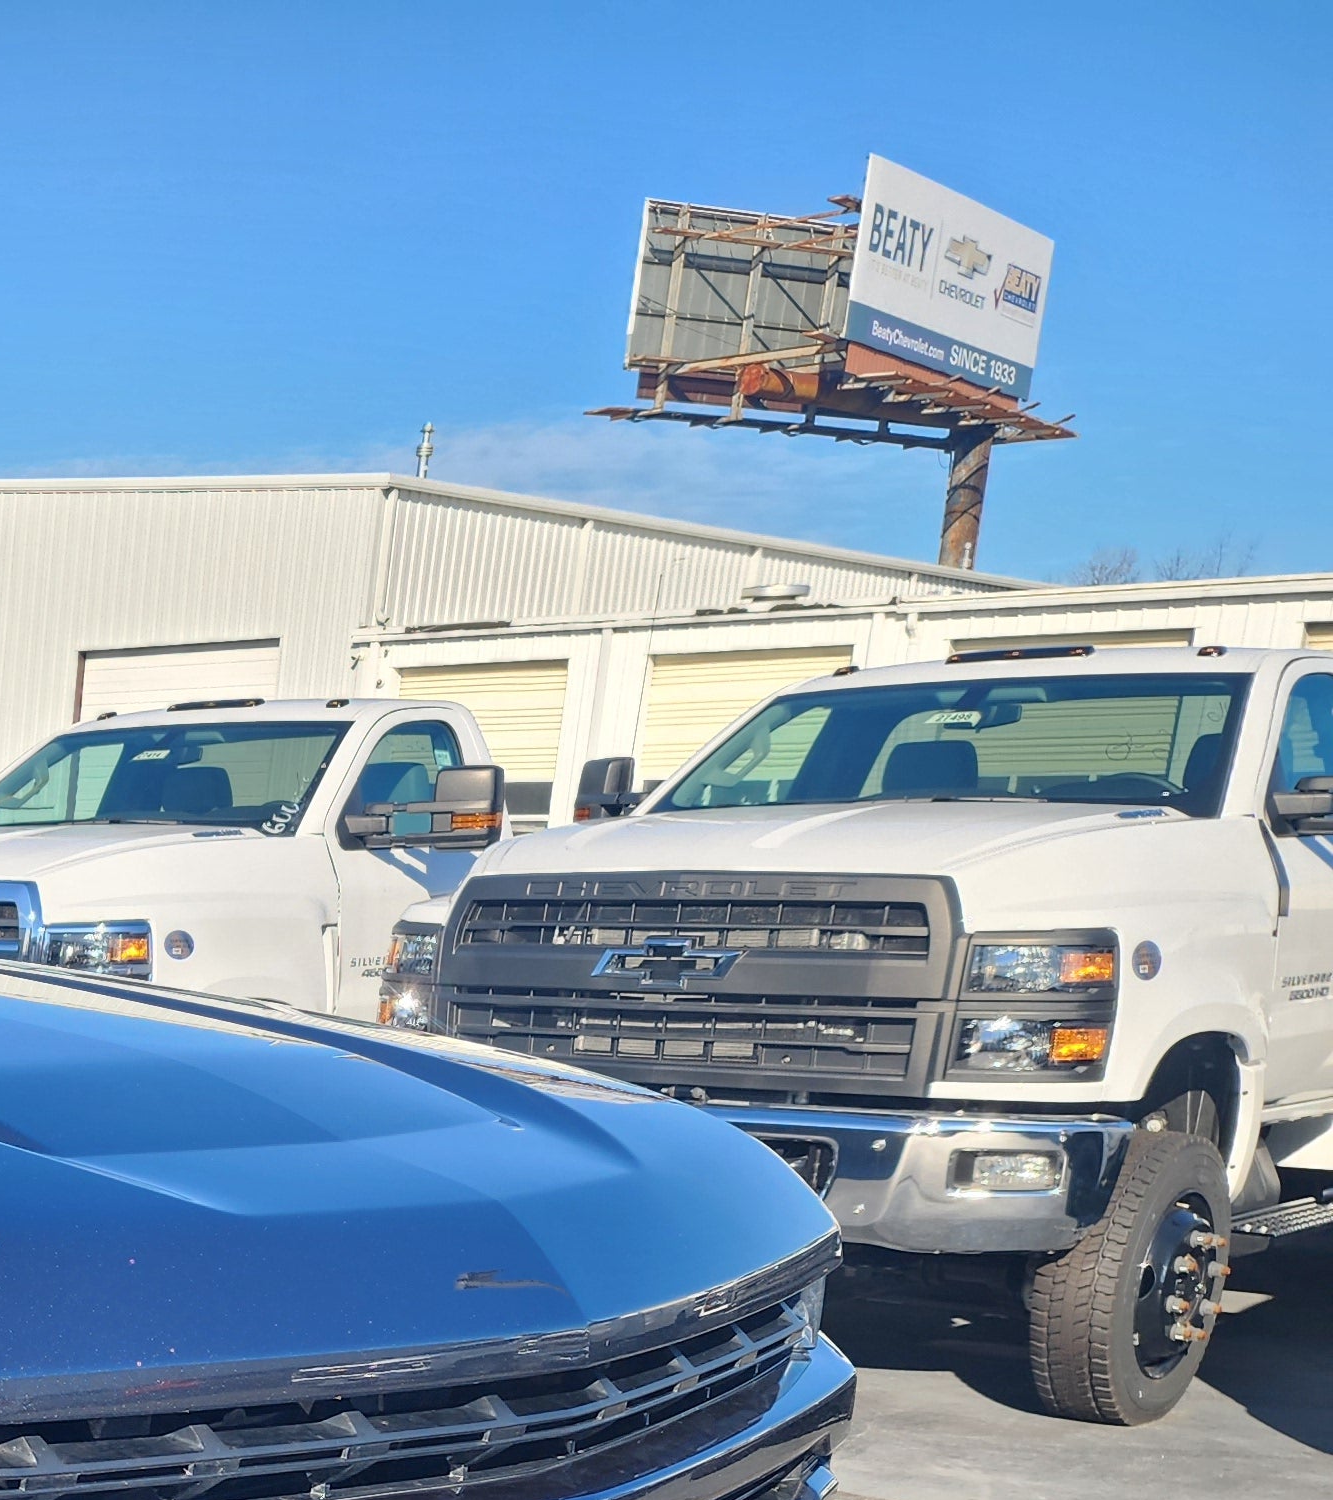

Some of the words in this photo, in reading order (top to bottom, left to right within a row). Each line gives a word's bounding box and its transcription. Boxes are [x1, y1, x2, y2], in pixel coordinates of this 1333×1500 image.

[868, 202, 934, 272] BEATY
[939, 279, 986, 310] CHEVROLET
[1004, 267, 1041, 302] BEATY
[871, 319, 945, 362] BeatyChevrolet.com
[949, 344, 987, 375] SINCE
[989, 359, 1016, 386] 1933
[526, 879, 858, 899] CHEVROLET
